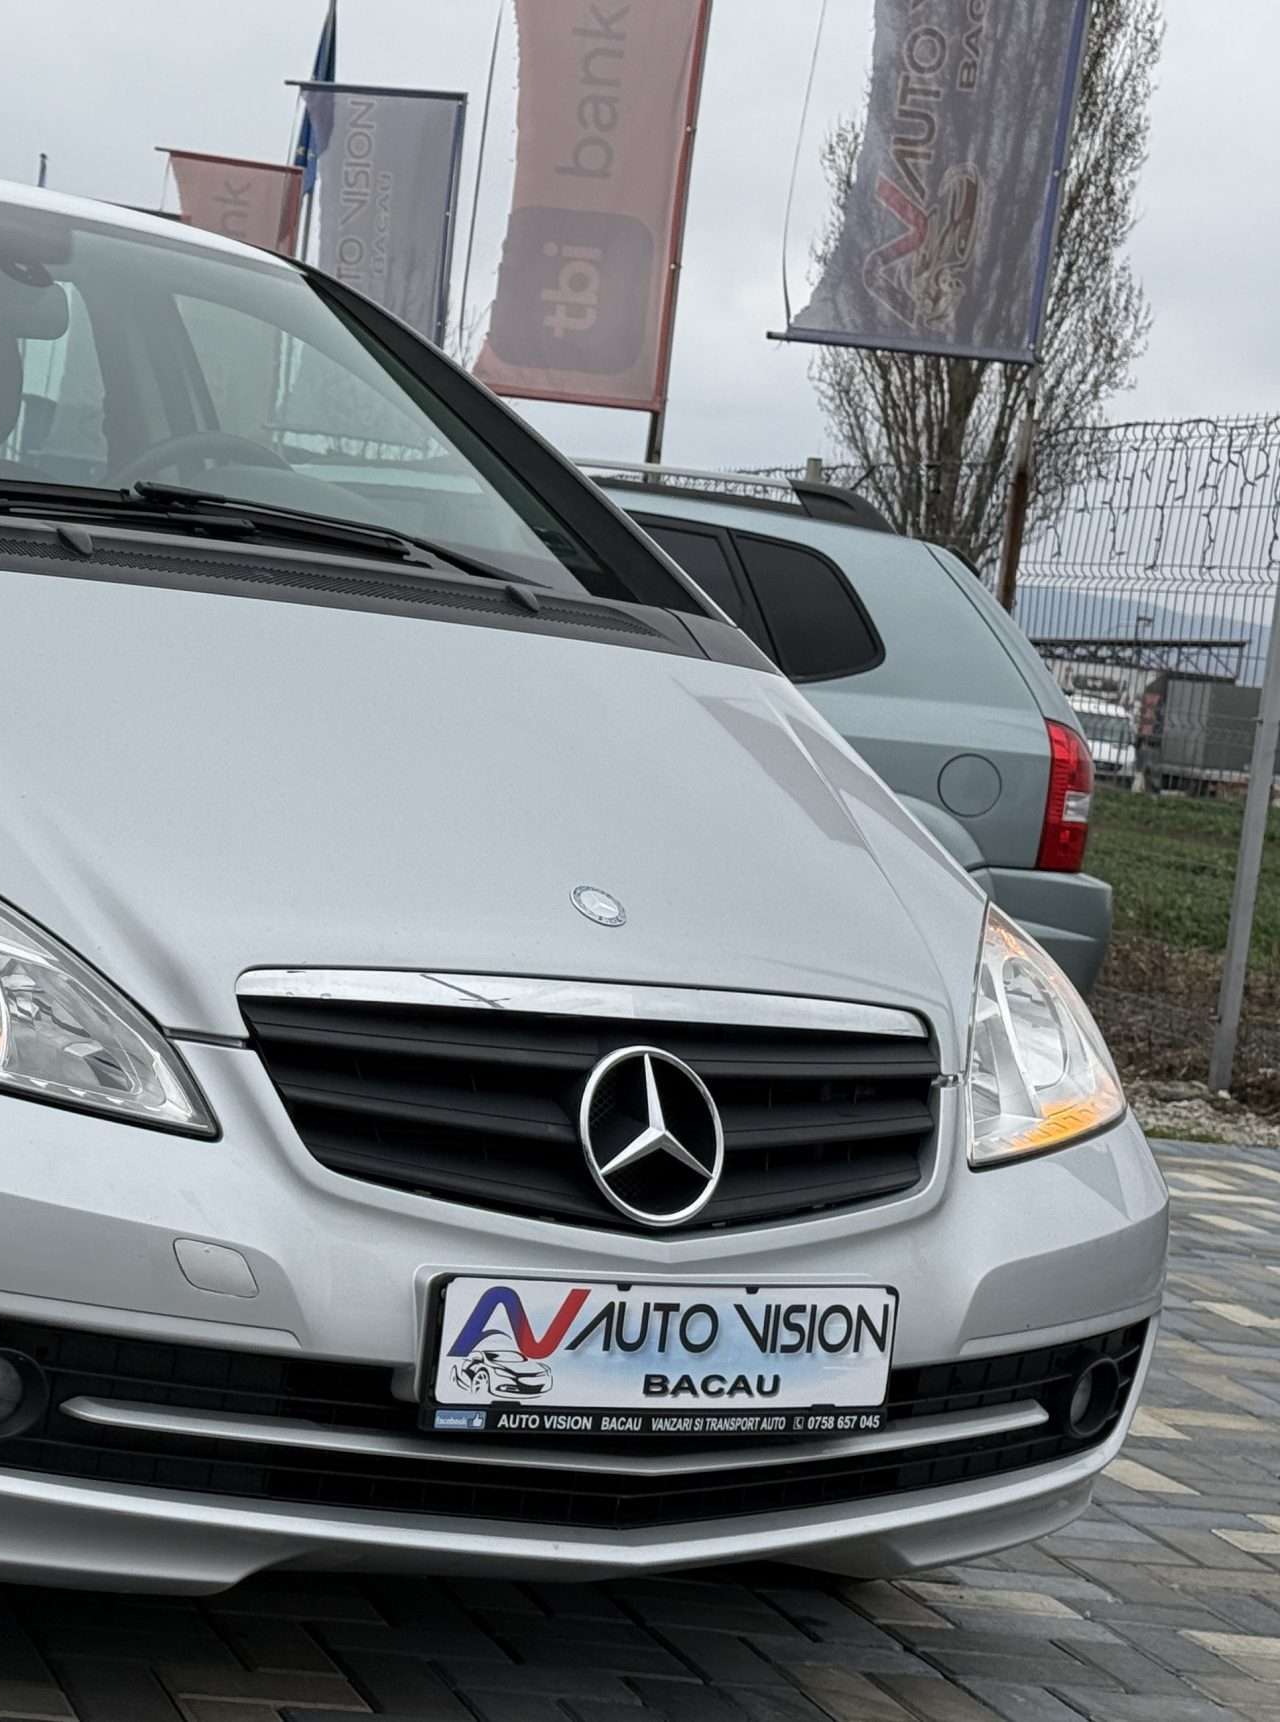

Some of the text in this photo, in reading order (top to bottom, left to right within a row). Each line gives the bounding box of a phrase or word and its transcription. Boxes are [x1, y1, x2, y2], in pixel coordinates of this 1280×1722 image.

[956, 0, 987, 92] BAC
[888, 25, 949, 206] AUTO
[339, 100, 376, 229] VISION
[541, 2, 632, 339] tbi bank
[565, 1300, 719, 1354] AUTO
[733, 1302, 890, 1354] VISION
[497, 1413, 540, 1429] AUTO
[543, 1414, 593, 1431] VISION
[600, 1416, 643, 1432] BACAU
[651, 1416, 693, 1432] VANZARI
[693, 1416, 704, 1431] SI
[704, 1416, 760, 1432] TRANSPORT
[759, 1416, 787, 1431] AUTO
[807, 1415, 835, 1430] 0758
[836, 1415, 858, 1430] 657
[859, 1414, 881, 1429] 045
[642, 1373, 781, 1398] BACAU
